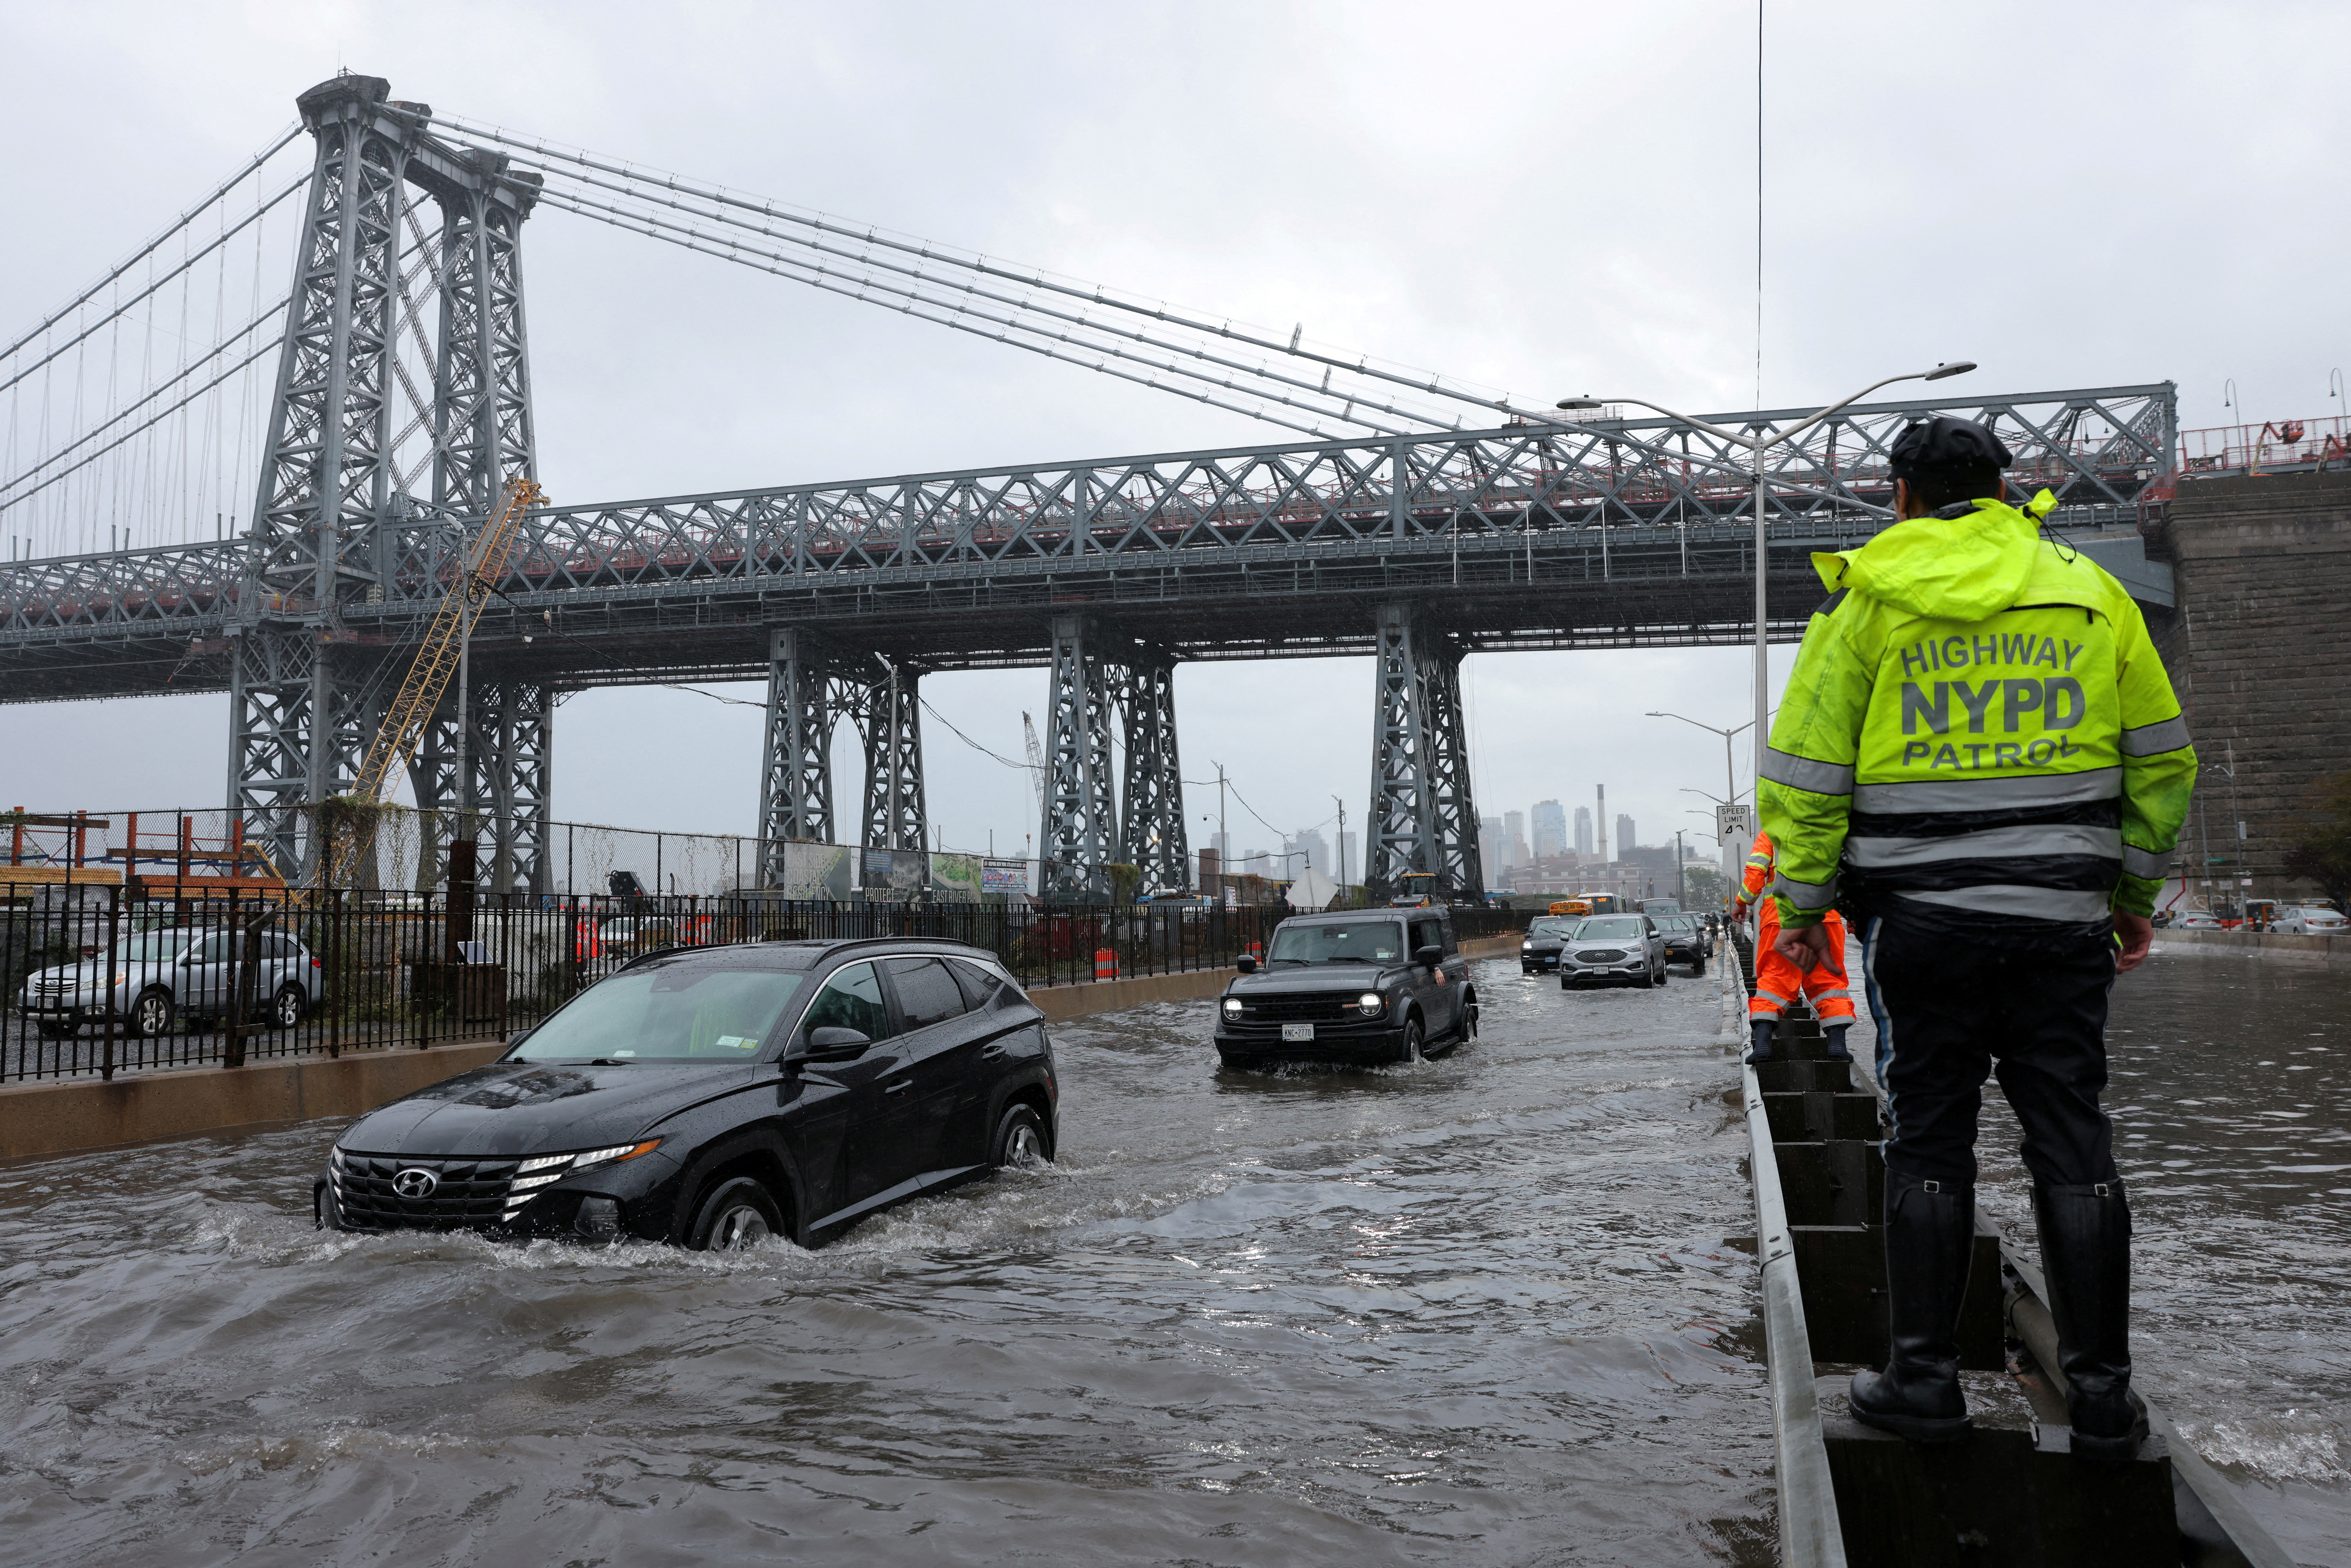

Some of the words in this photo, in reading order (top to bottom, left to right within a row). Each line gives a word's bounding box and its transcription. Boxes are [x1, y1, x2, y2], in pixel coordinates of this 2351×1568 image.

[1900, 633, 2084, 678] HIGHWAY
[1902, 677, 2085, 734] NYPD
[1903, 734, 2080, 769] PATROL
[787, 851, 807, 867] EAST
[809, 853, 824, 868] SIDE
[787, 869, 821, 884] COASTAL
[787, 885, 830, 901] RESILIENCY
[865, 887, 894, 902] PROTECT
[933, 890, 948, 903] EAST
[949, 890, 966, 903] RIVER
[967, 891, 979, 904] PARK
[1298, 1029, 1311, 1037] 2770
